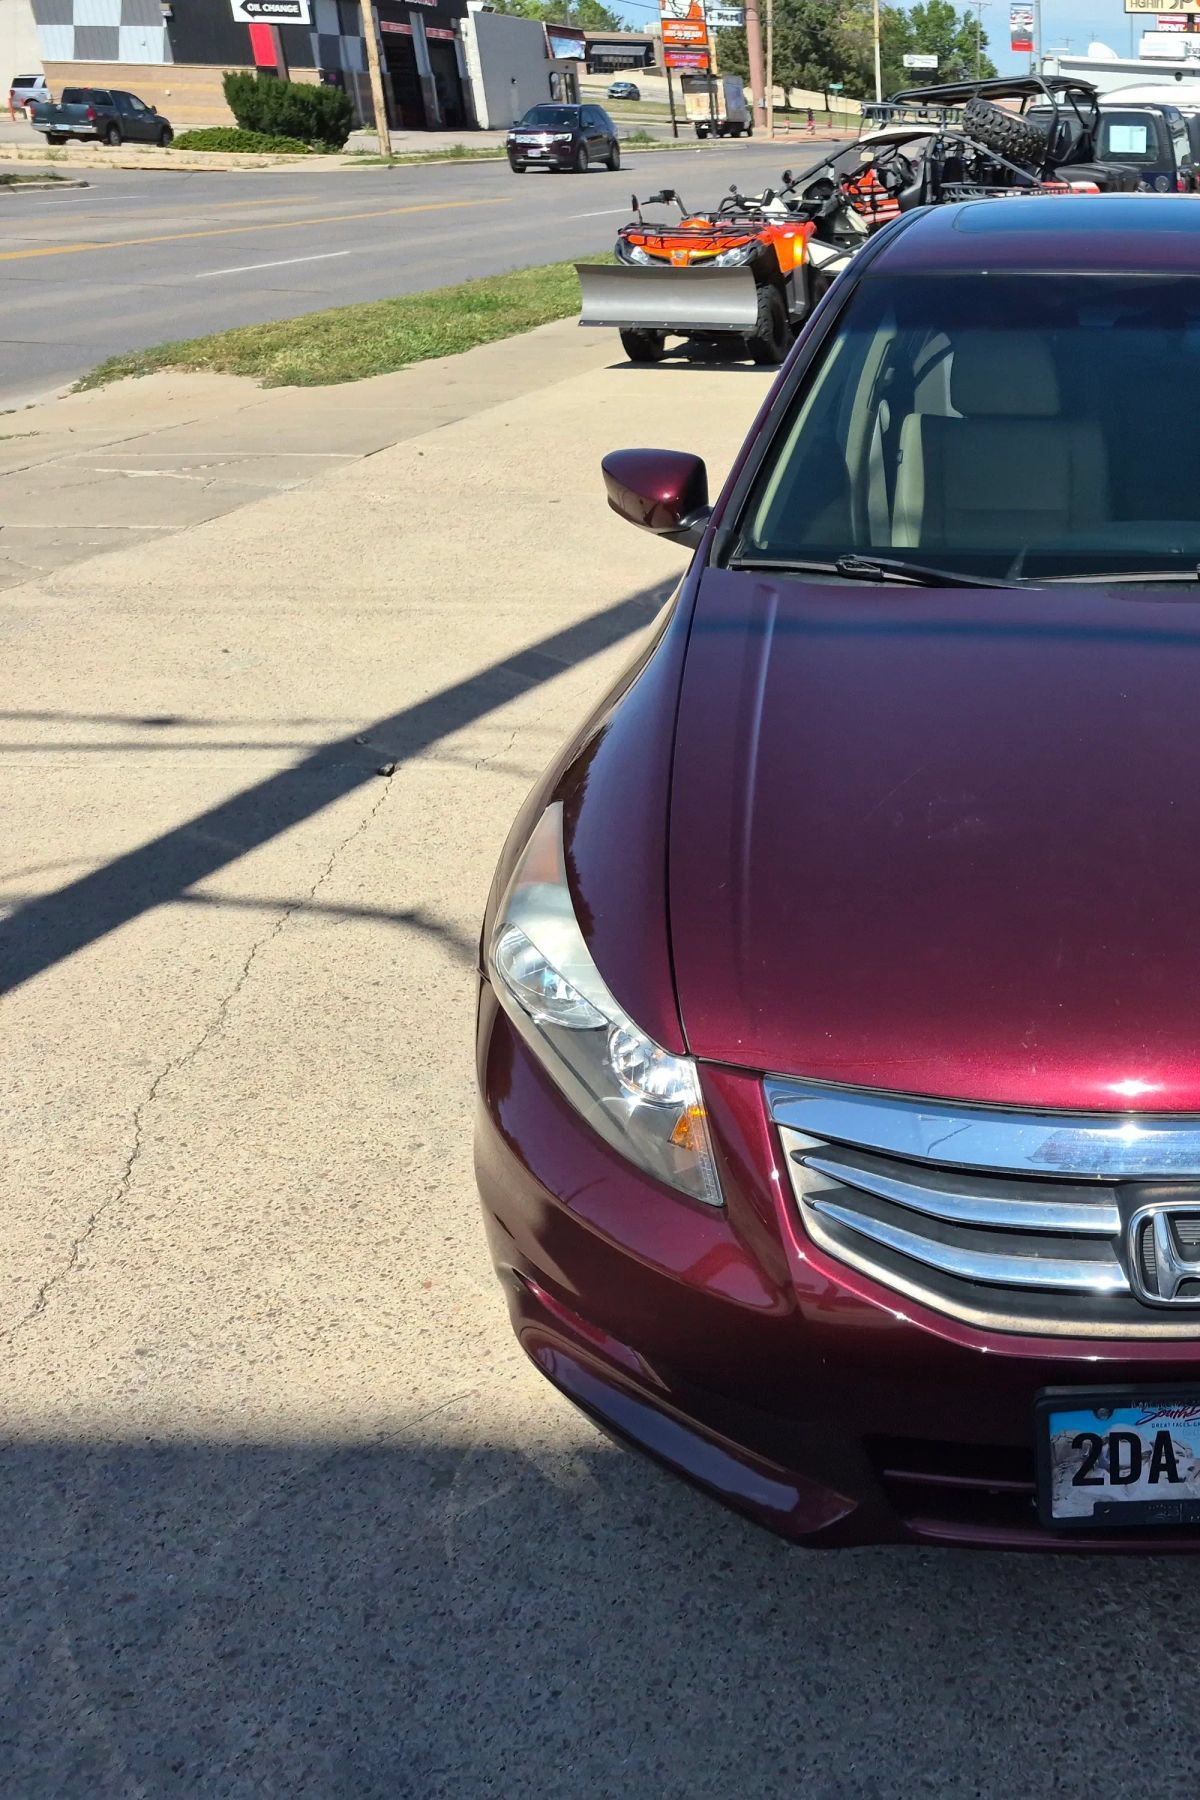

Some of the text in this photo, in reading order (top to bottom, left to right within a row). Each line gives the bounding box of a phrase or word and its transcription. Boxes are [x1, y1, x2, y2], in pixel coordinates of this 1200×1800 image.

[247, 3, 299, 13] OIL CHANGE
[1071, 1429, 1183, 1487] 2DA
